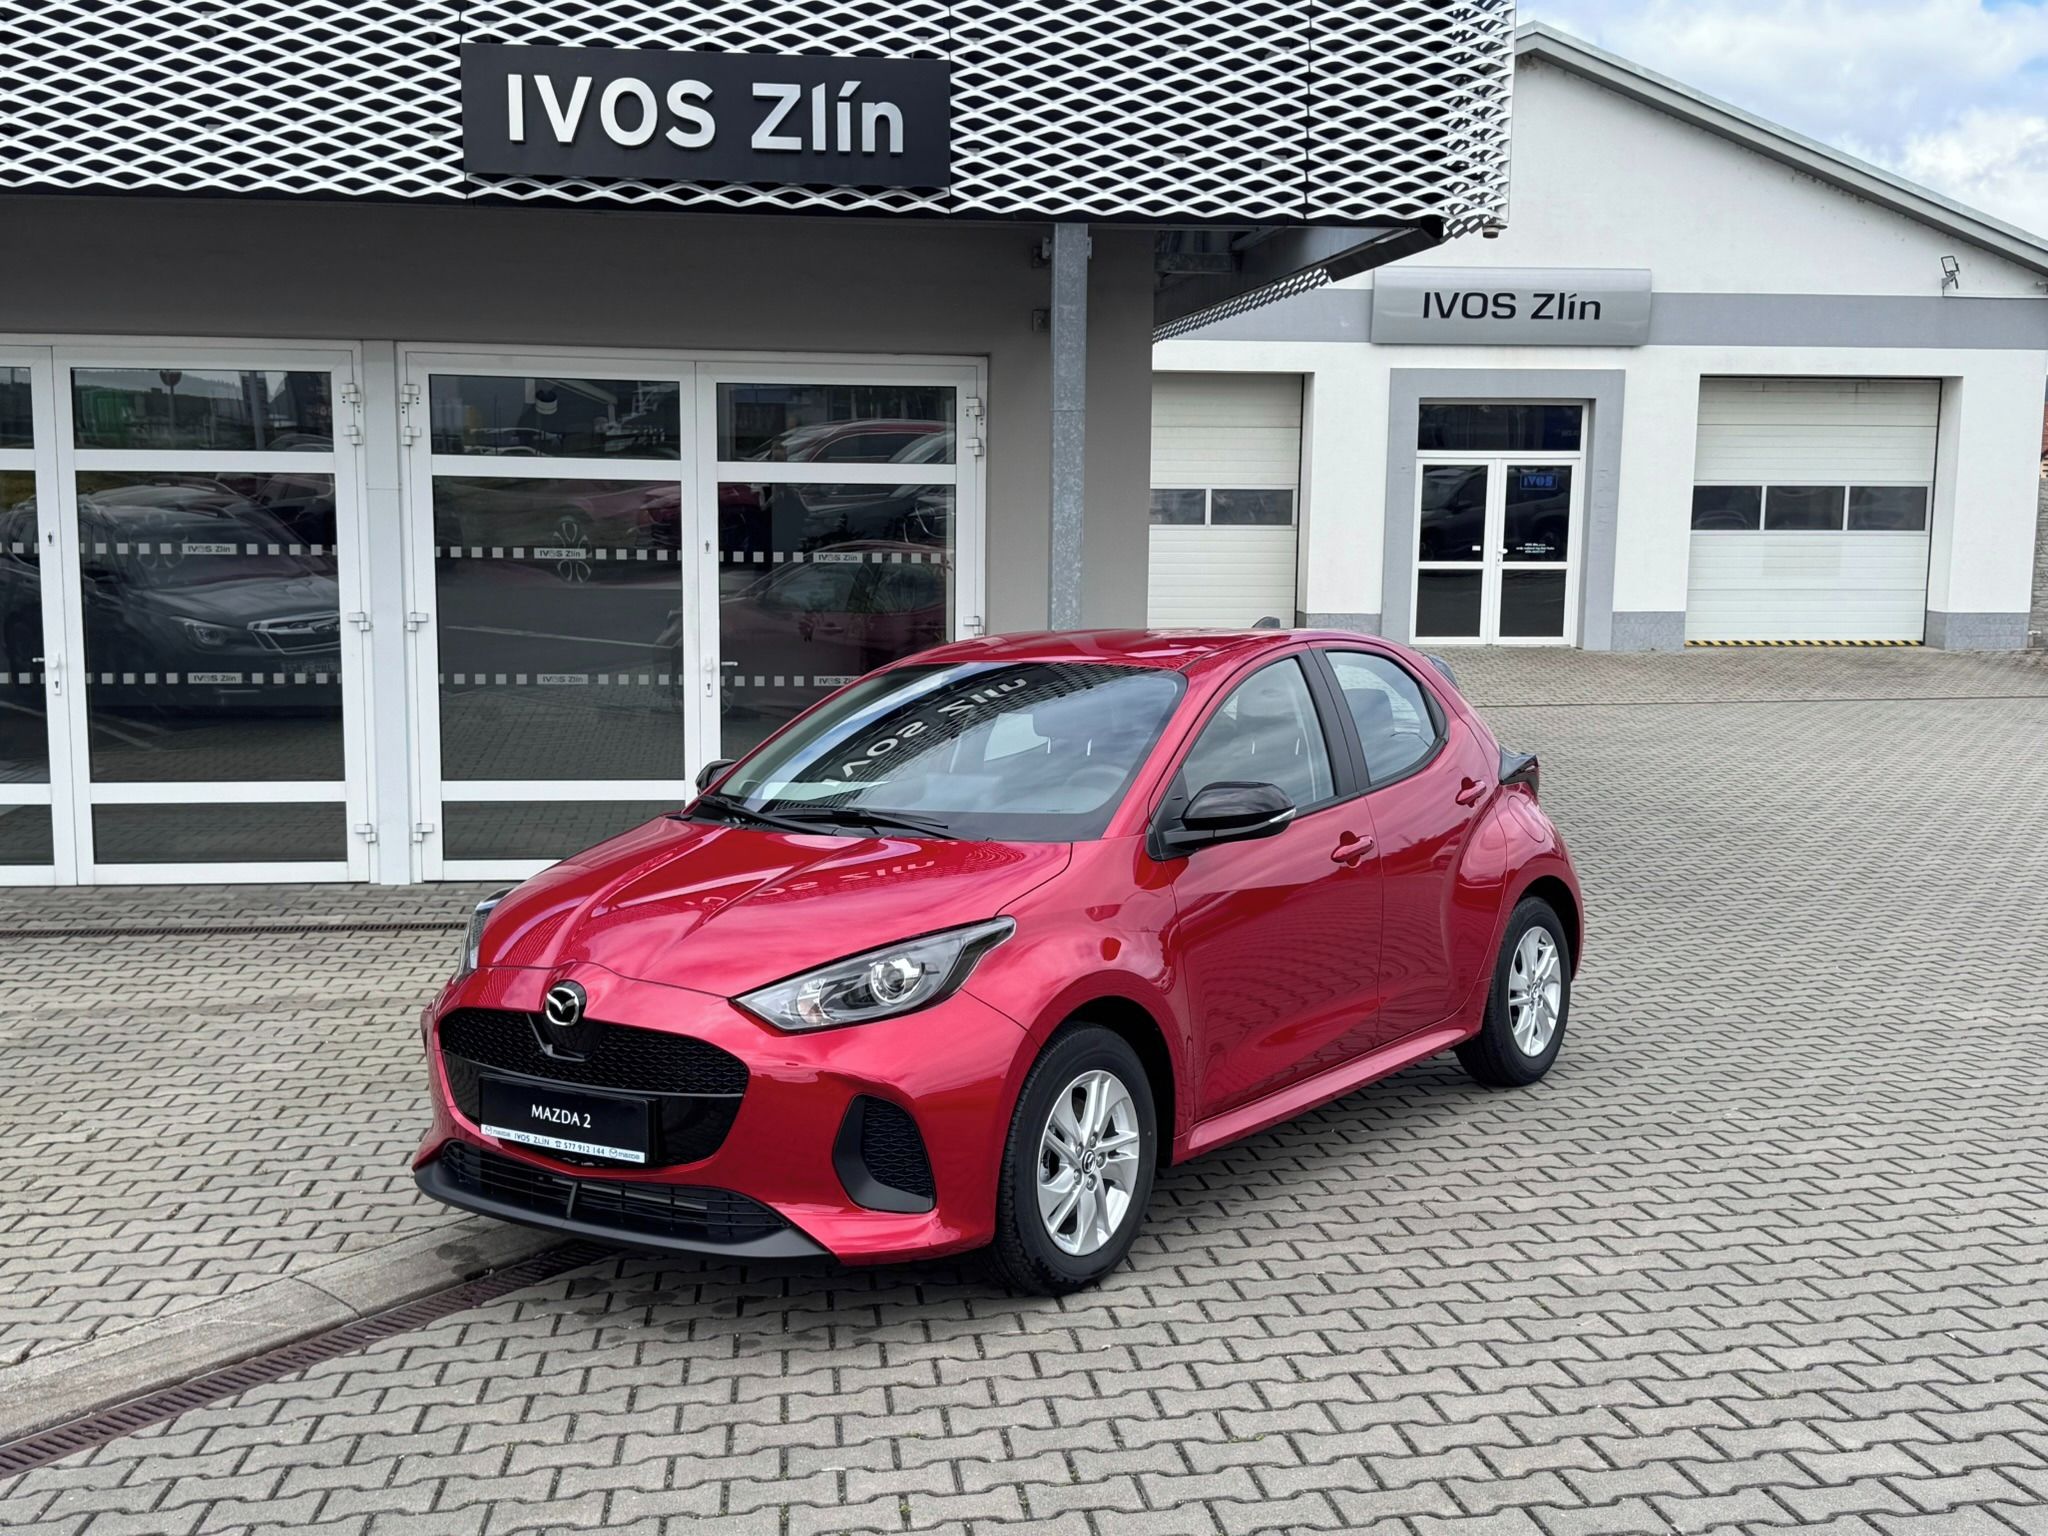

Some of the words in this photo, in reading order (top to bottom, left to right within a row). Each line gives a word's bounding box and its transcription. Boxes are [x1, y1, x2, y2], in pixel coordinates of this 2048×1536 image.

[507, 73, 716, 149] IVOS
[751, 80, 904, 153] Zlín
[1422, 291, 1517, 320] IVOS
[1530, 292, 1601, 320] Zlín
[531, 1103, 581, 1127] MAZDA
[583, 1113, 592, 1129] 2
[514, 1132, 531, 1143] IVOS
[563, 1142, 576, 1150] 577
[578, 1145, 590, 1153] 912
[592, 1147, 605, 1155] 144
